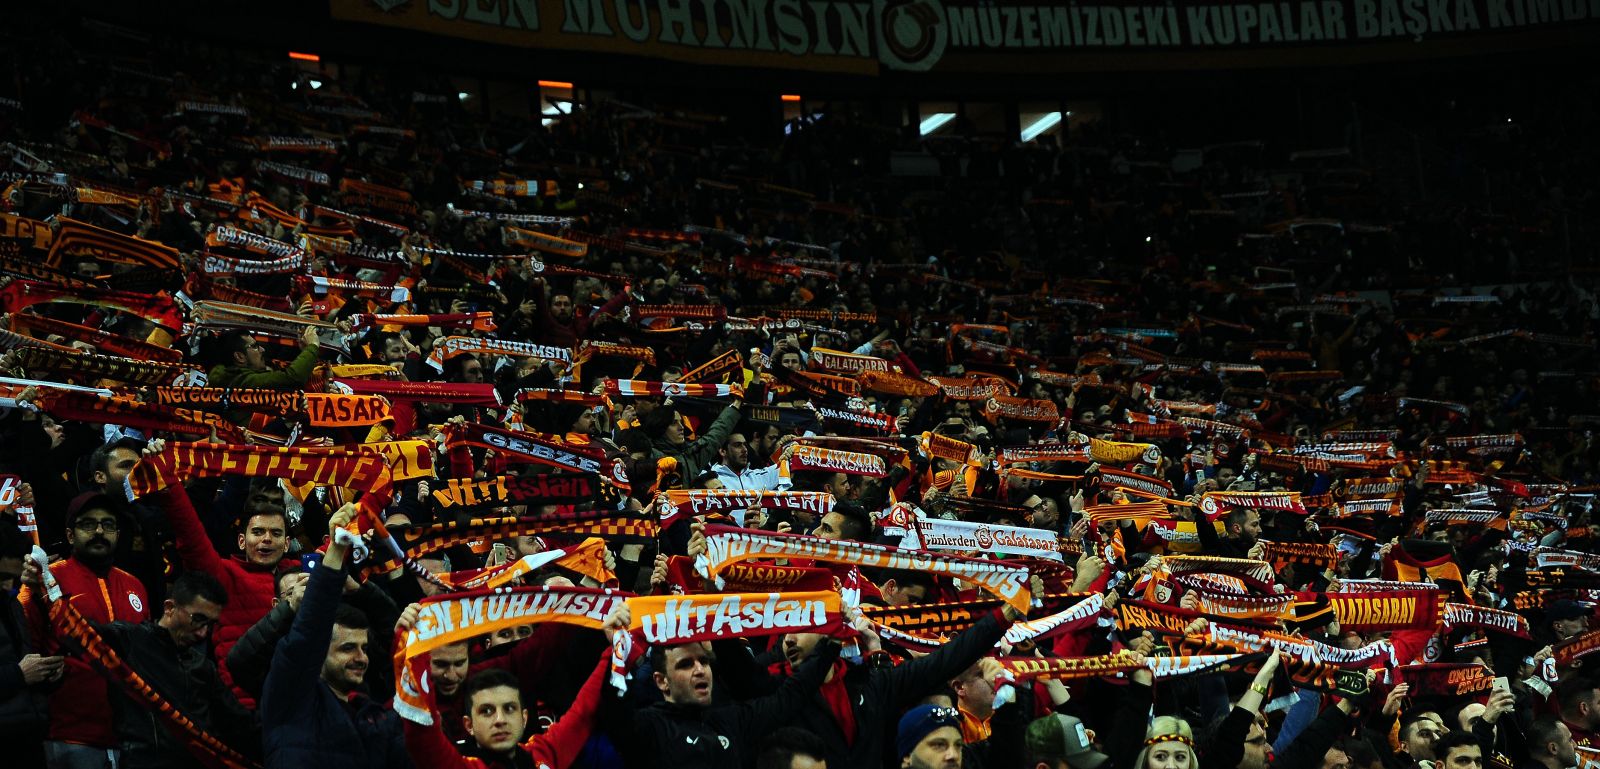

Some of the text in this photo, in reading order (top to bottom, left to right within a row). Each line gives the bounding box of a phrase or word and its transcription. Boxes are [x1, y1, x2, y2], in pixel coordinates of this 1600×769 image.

[1186, 2, 1348, 46] KUPALAR
[1354, 0, 1480, 43] BAŞKA
[824, 357, 889, 373] GALATASARAY
[481, 432, 601, 473] GEBZE
[641, 592, 828, 643] ultrAslan
[1330, 597, 1417, 625] ALATASARAY
